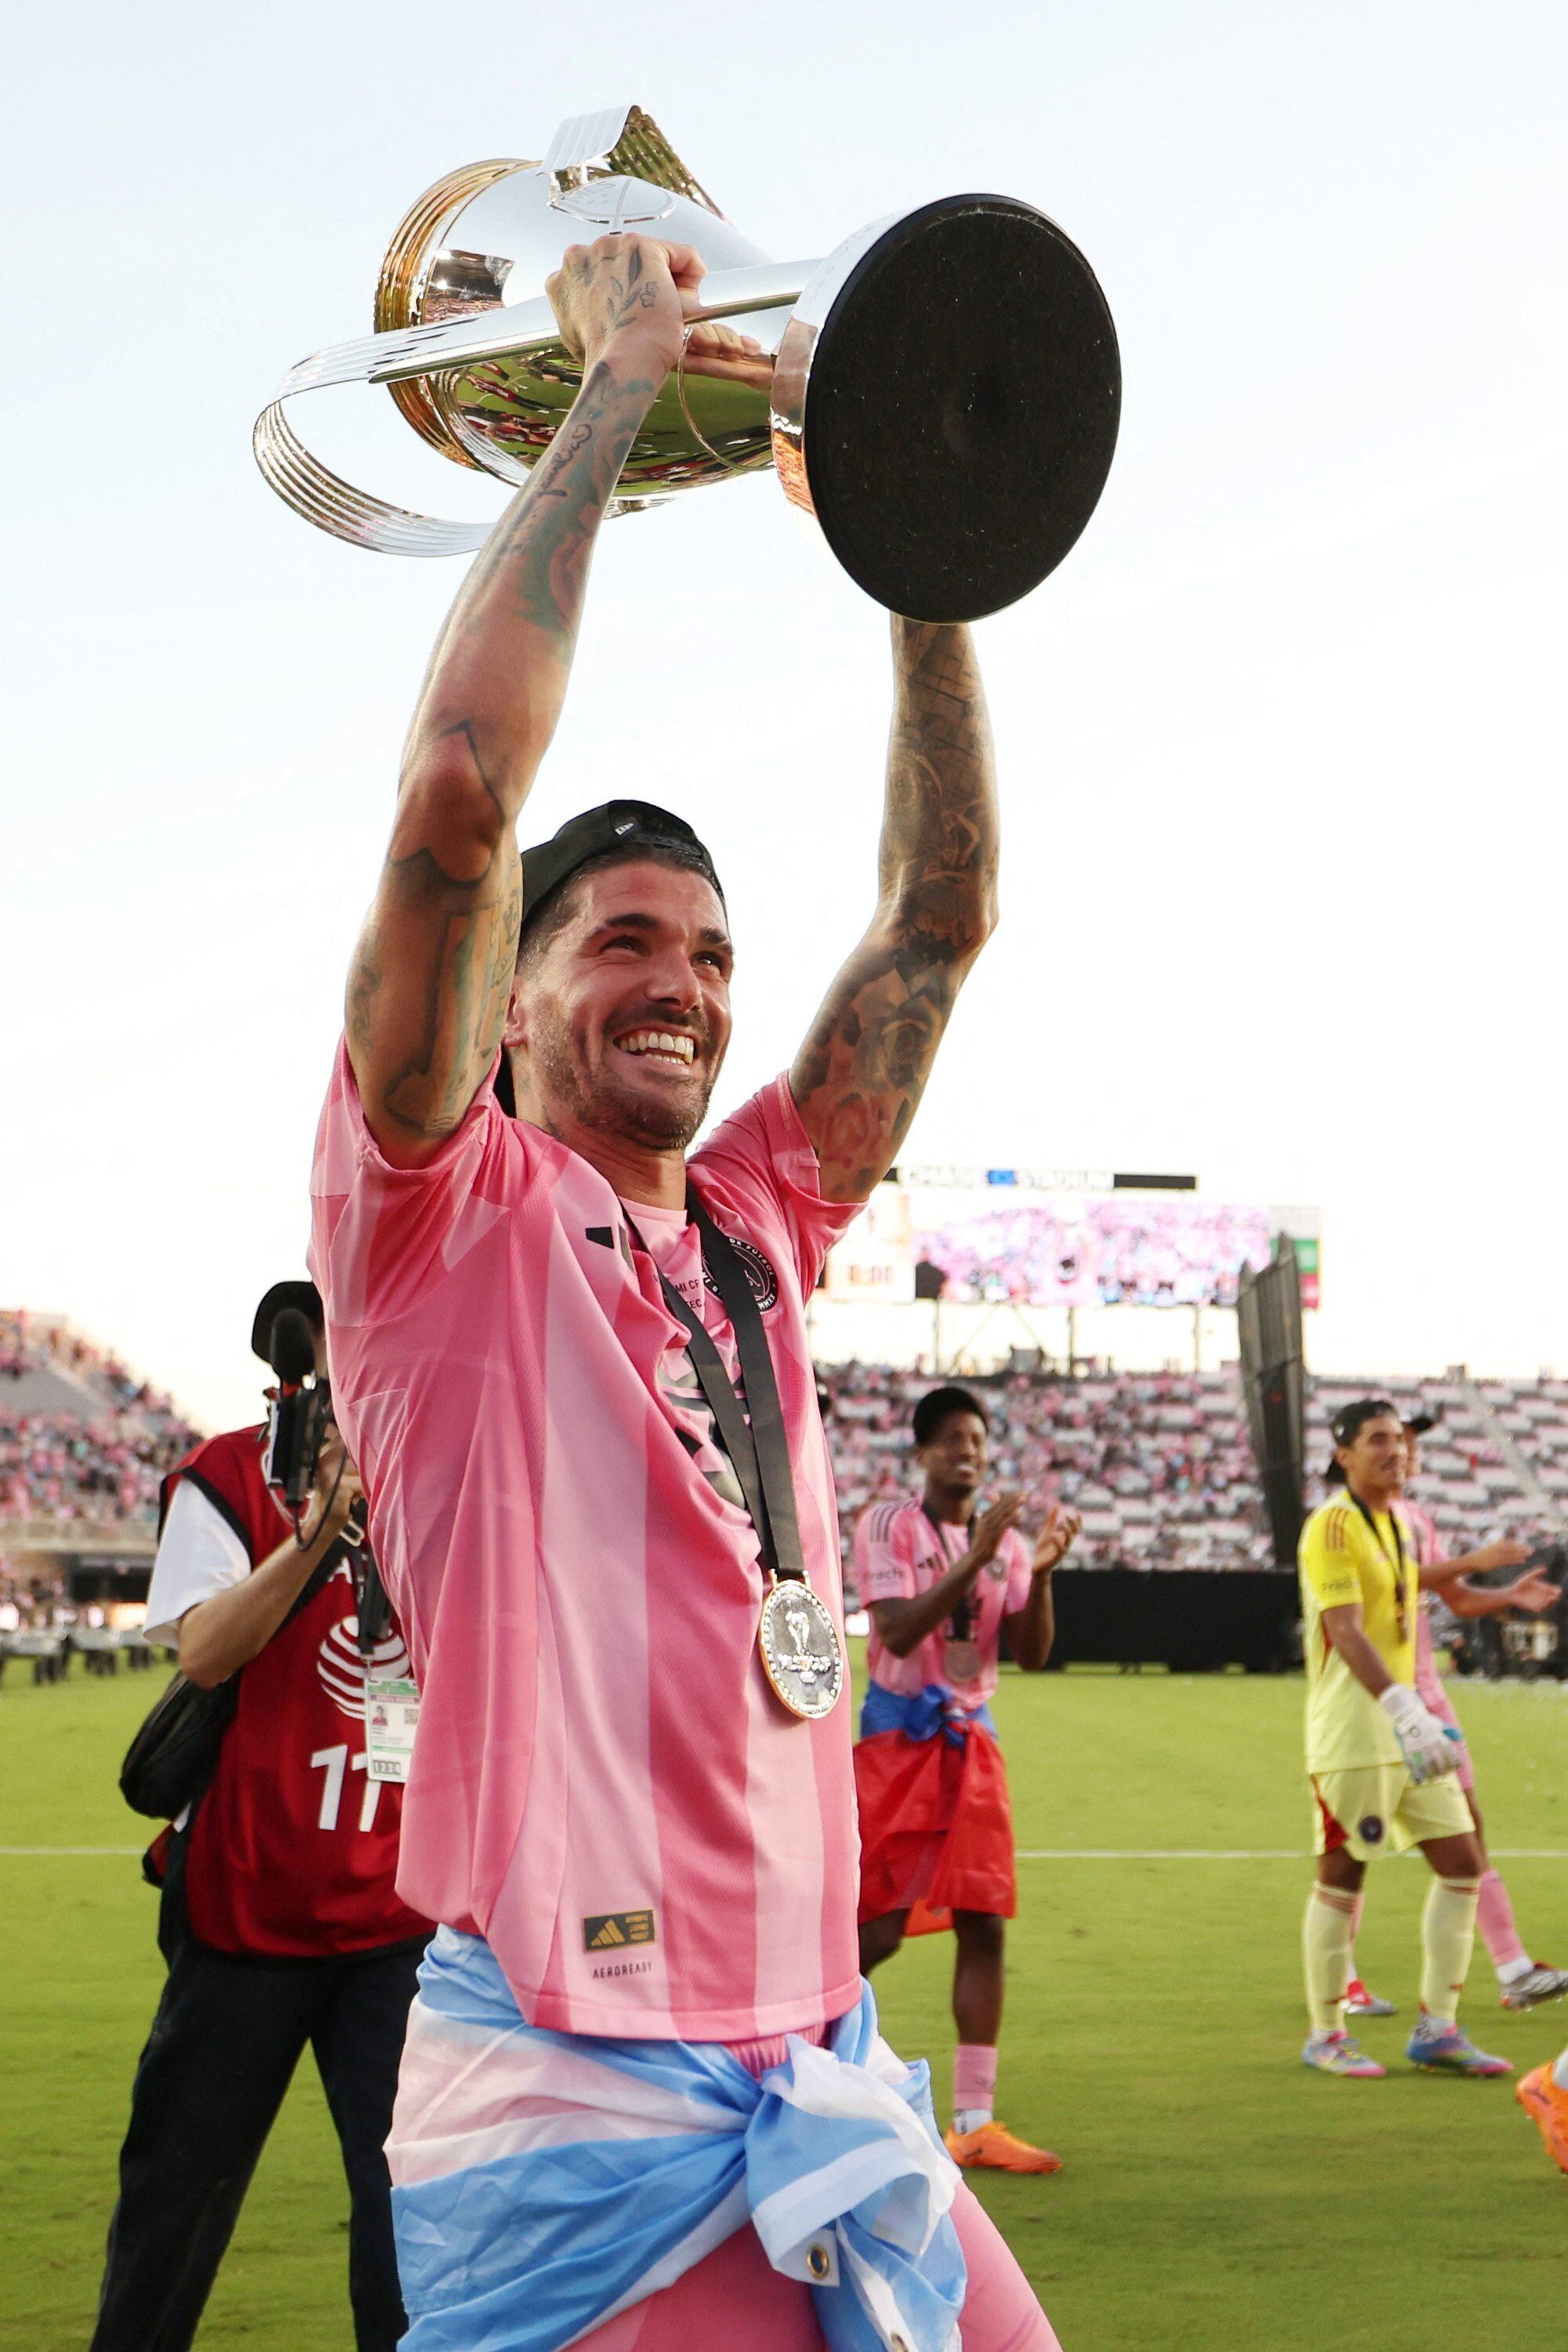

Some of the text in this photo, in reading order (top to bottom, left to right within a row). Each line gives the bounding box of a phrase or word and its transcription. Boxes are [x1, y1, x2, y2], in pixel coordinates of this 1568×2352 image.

[688, 1279, 699, 1289] CF
[757, 1293, 775, 1310] MMXX
[593, 1962, 652, 1979] AEROREADY
